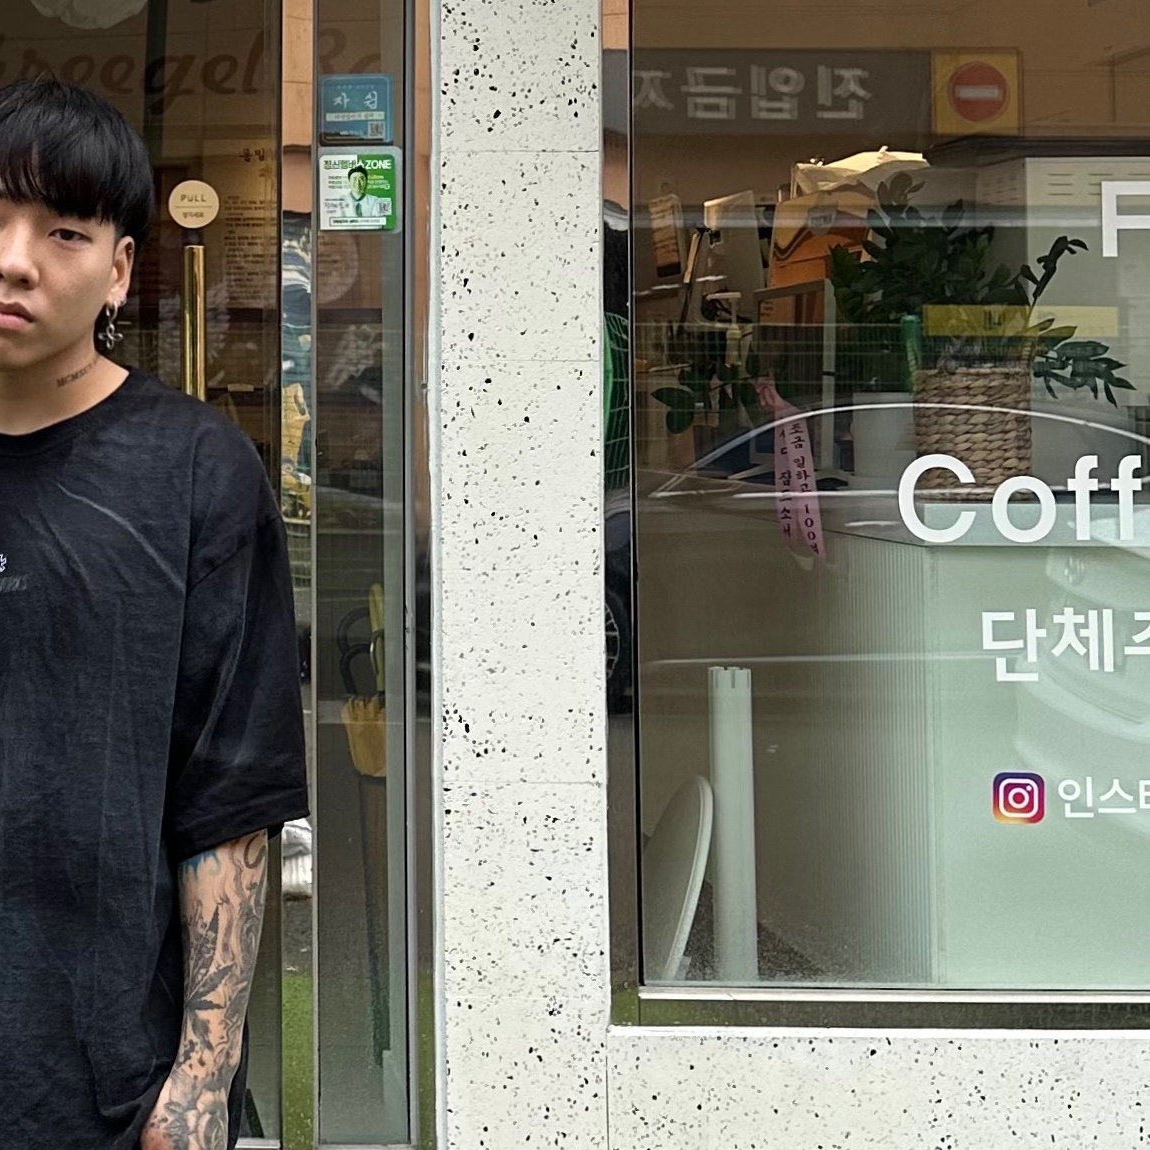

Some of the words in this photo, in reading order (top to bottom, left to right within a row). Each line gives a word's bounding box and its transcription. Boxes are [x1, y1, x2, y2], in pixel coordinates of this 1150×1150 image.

[365, 159, 391, 169] ZONE
[180, 194, 206, 202] PULL
[789, 423, 805, 449] 조금
[898, 453, 1142, 543] Coff
